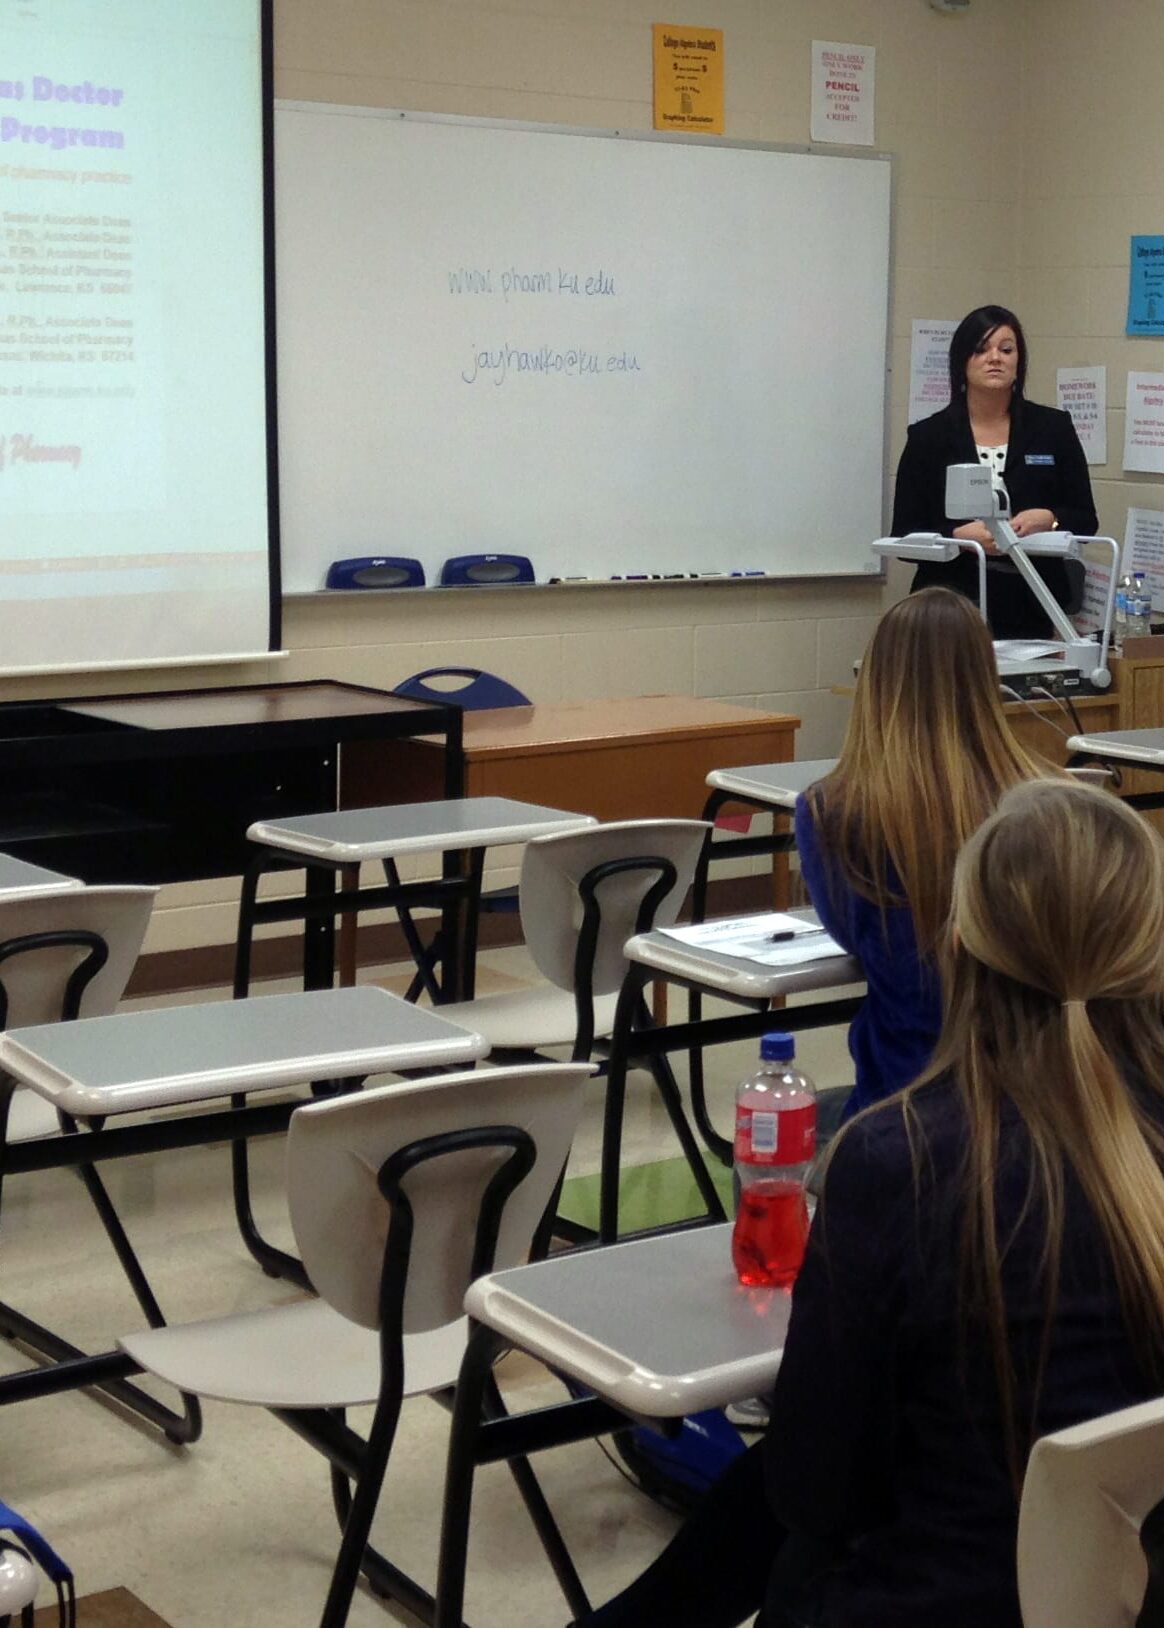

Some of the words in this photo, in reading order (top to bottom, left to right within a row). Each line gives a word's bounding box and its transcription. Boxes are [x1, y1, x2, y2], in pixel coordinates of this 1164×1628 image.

[33, 75, 124, 107] Doctor
[825, 81, 860, 92] PENCIL
[1, 116, 124, 150] Program
[1059, 381, 1096, 391] HOMEWORK
